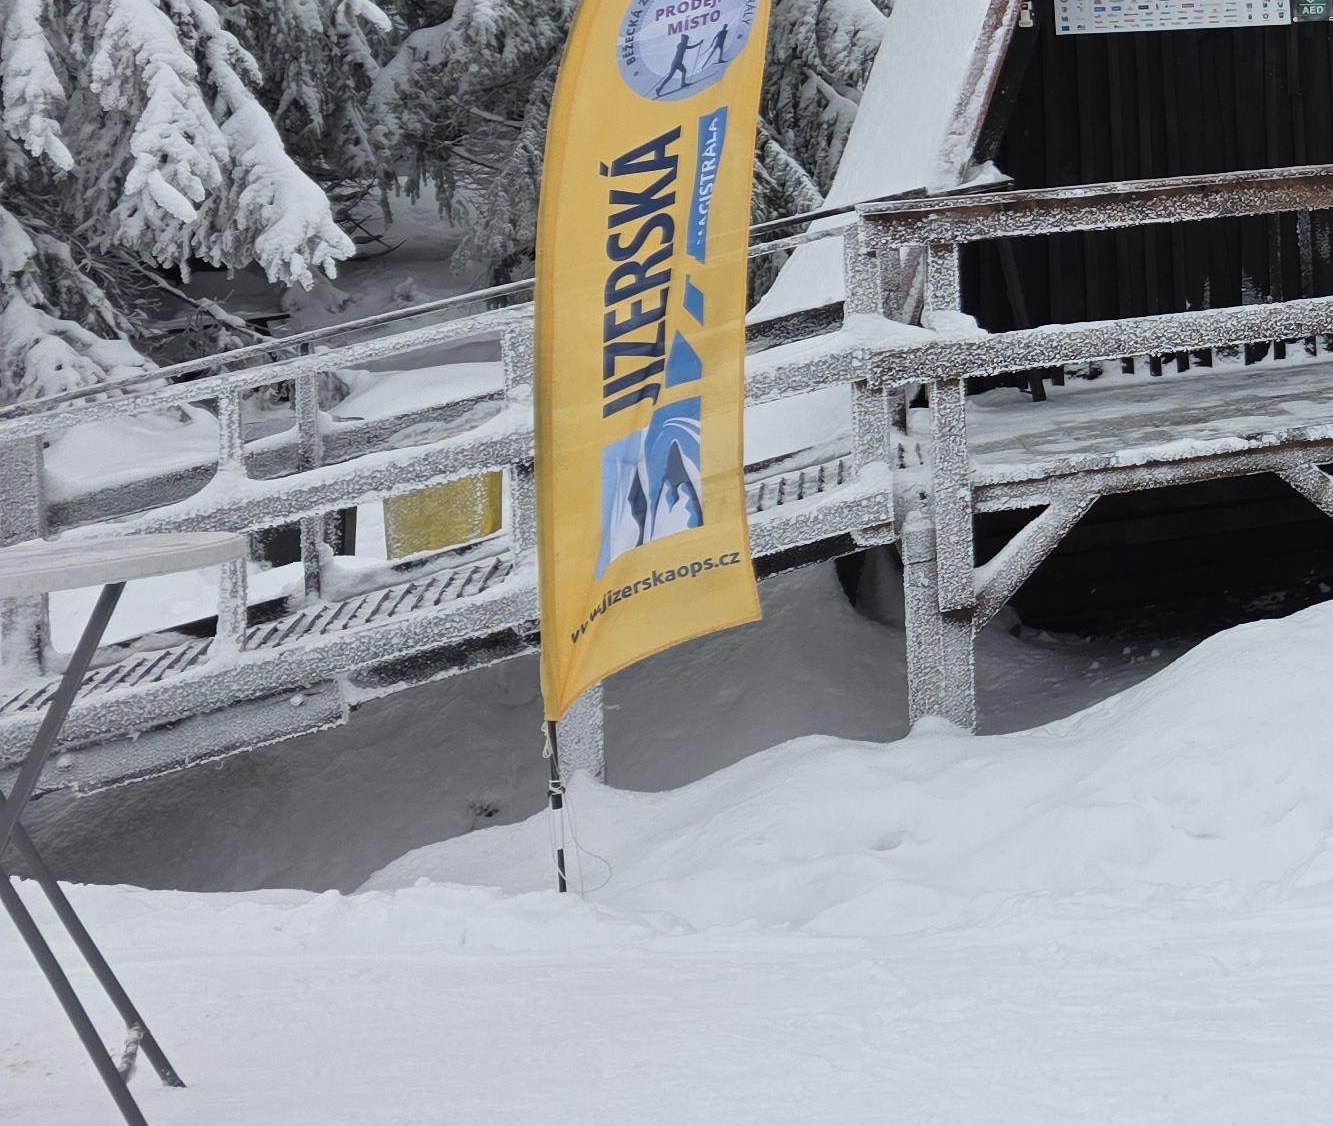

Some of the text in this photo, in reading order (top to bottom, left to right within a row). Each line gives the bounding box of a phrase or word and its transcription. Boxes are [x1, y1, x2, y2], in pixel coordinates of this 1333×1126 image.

[667, 10, 721, 36] MÍSTO
[1302, 5, 1324, 15] AED
[622, 9, 643, 66] BĚŽECKÁ
[599, 124, 682, 419] JIZERSKÁ
